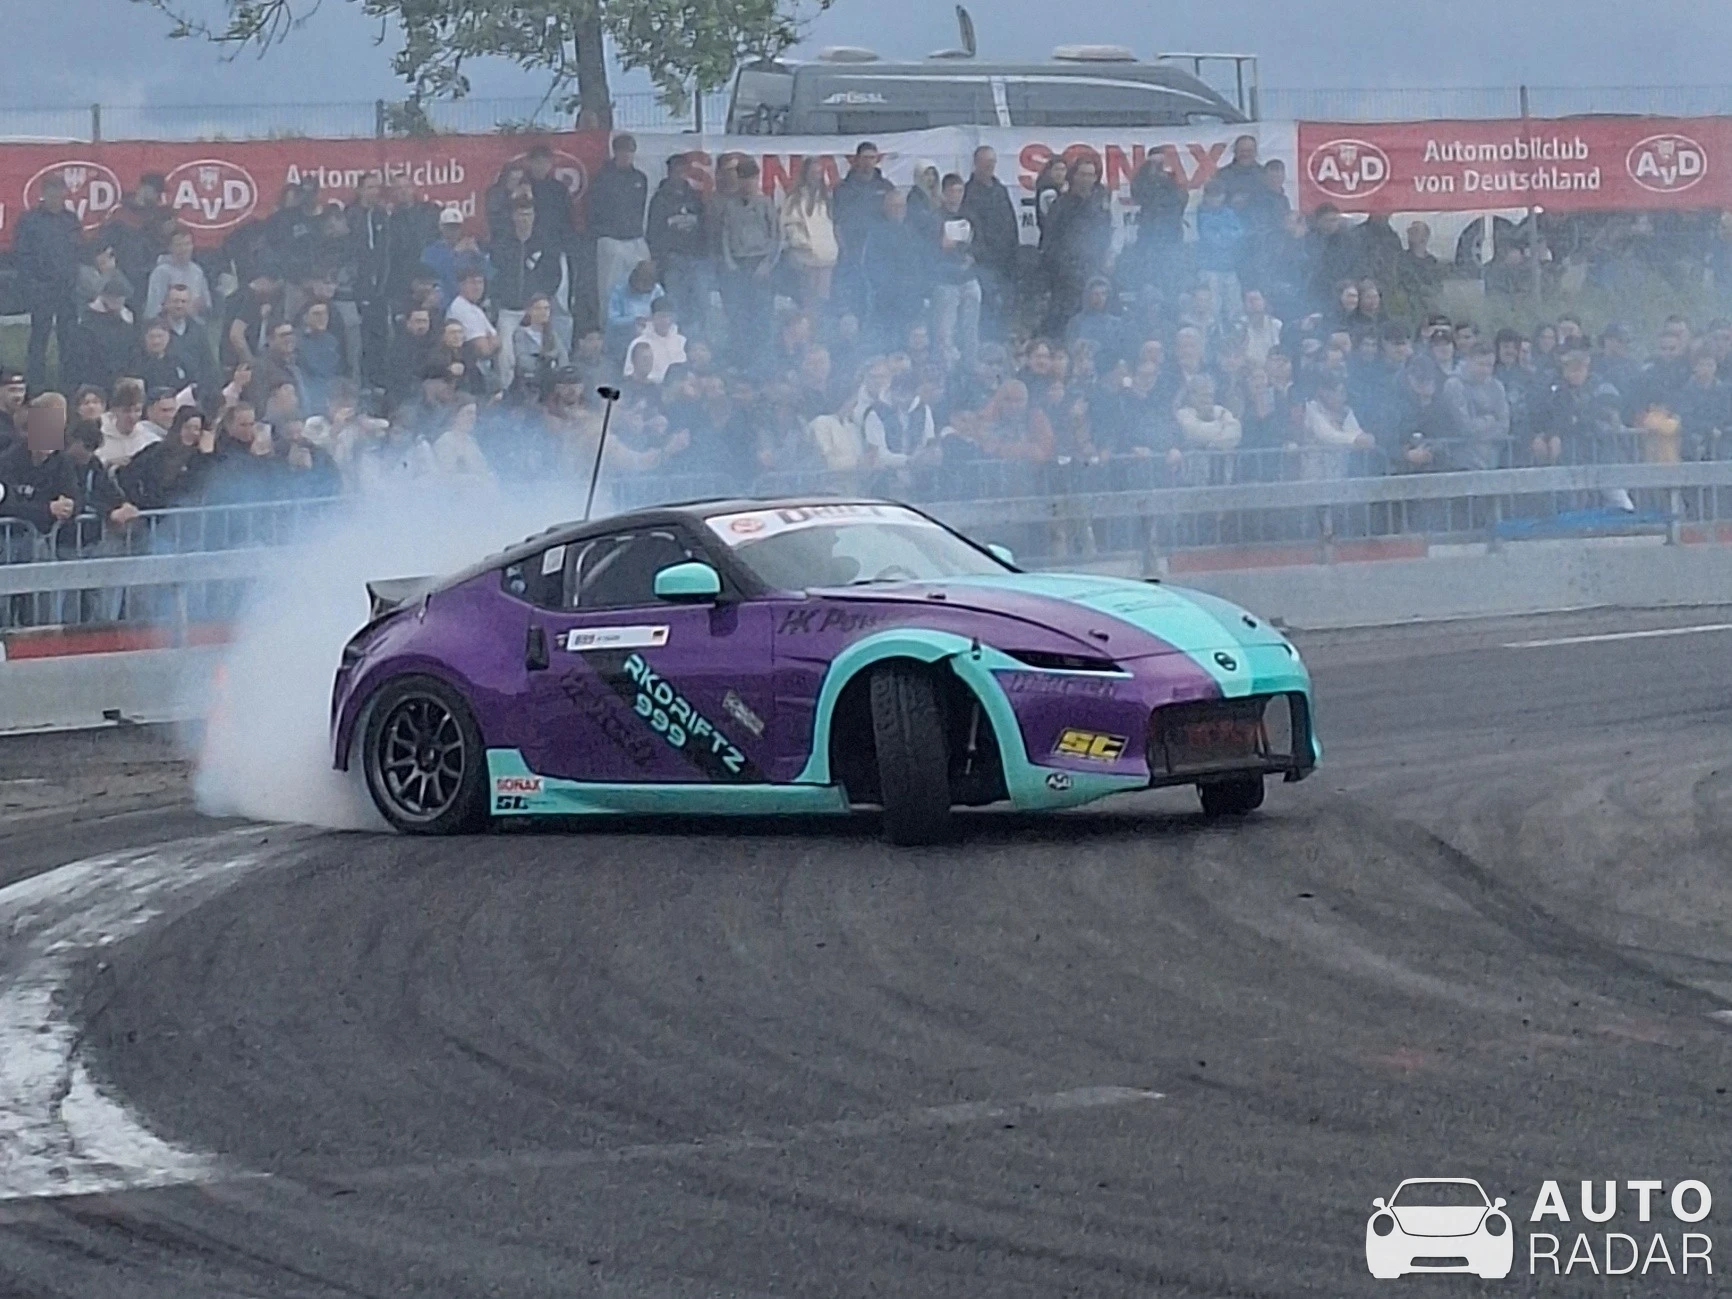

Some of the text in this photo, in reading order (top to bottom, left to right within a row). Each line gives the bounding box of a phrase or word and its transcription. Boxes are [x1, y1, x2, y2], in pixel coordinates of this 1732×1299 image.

[1423, 137, 1588, 162] Automobilclub
[1414, 167, 1601, 193] von Deutschland
[623, 653, 746, 775] RKDRIFTZ
[634, 692, 687, 748] 999
